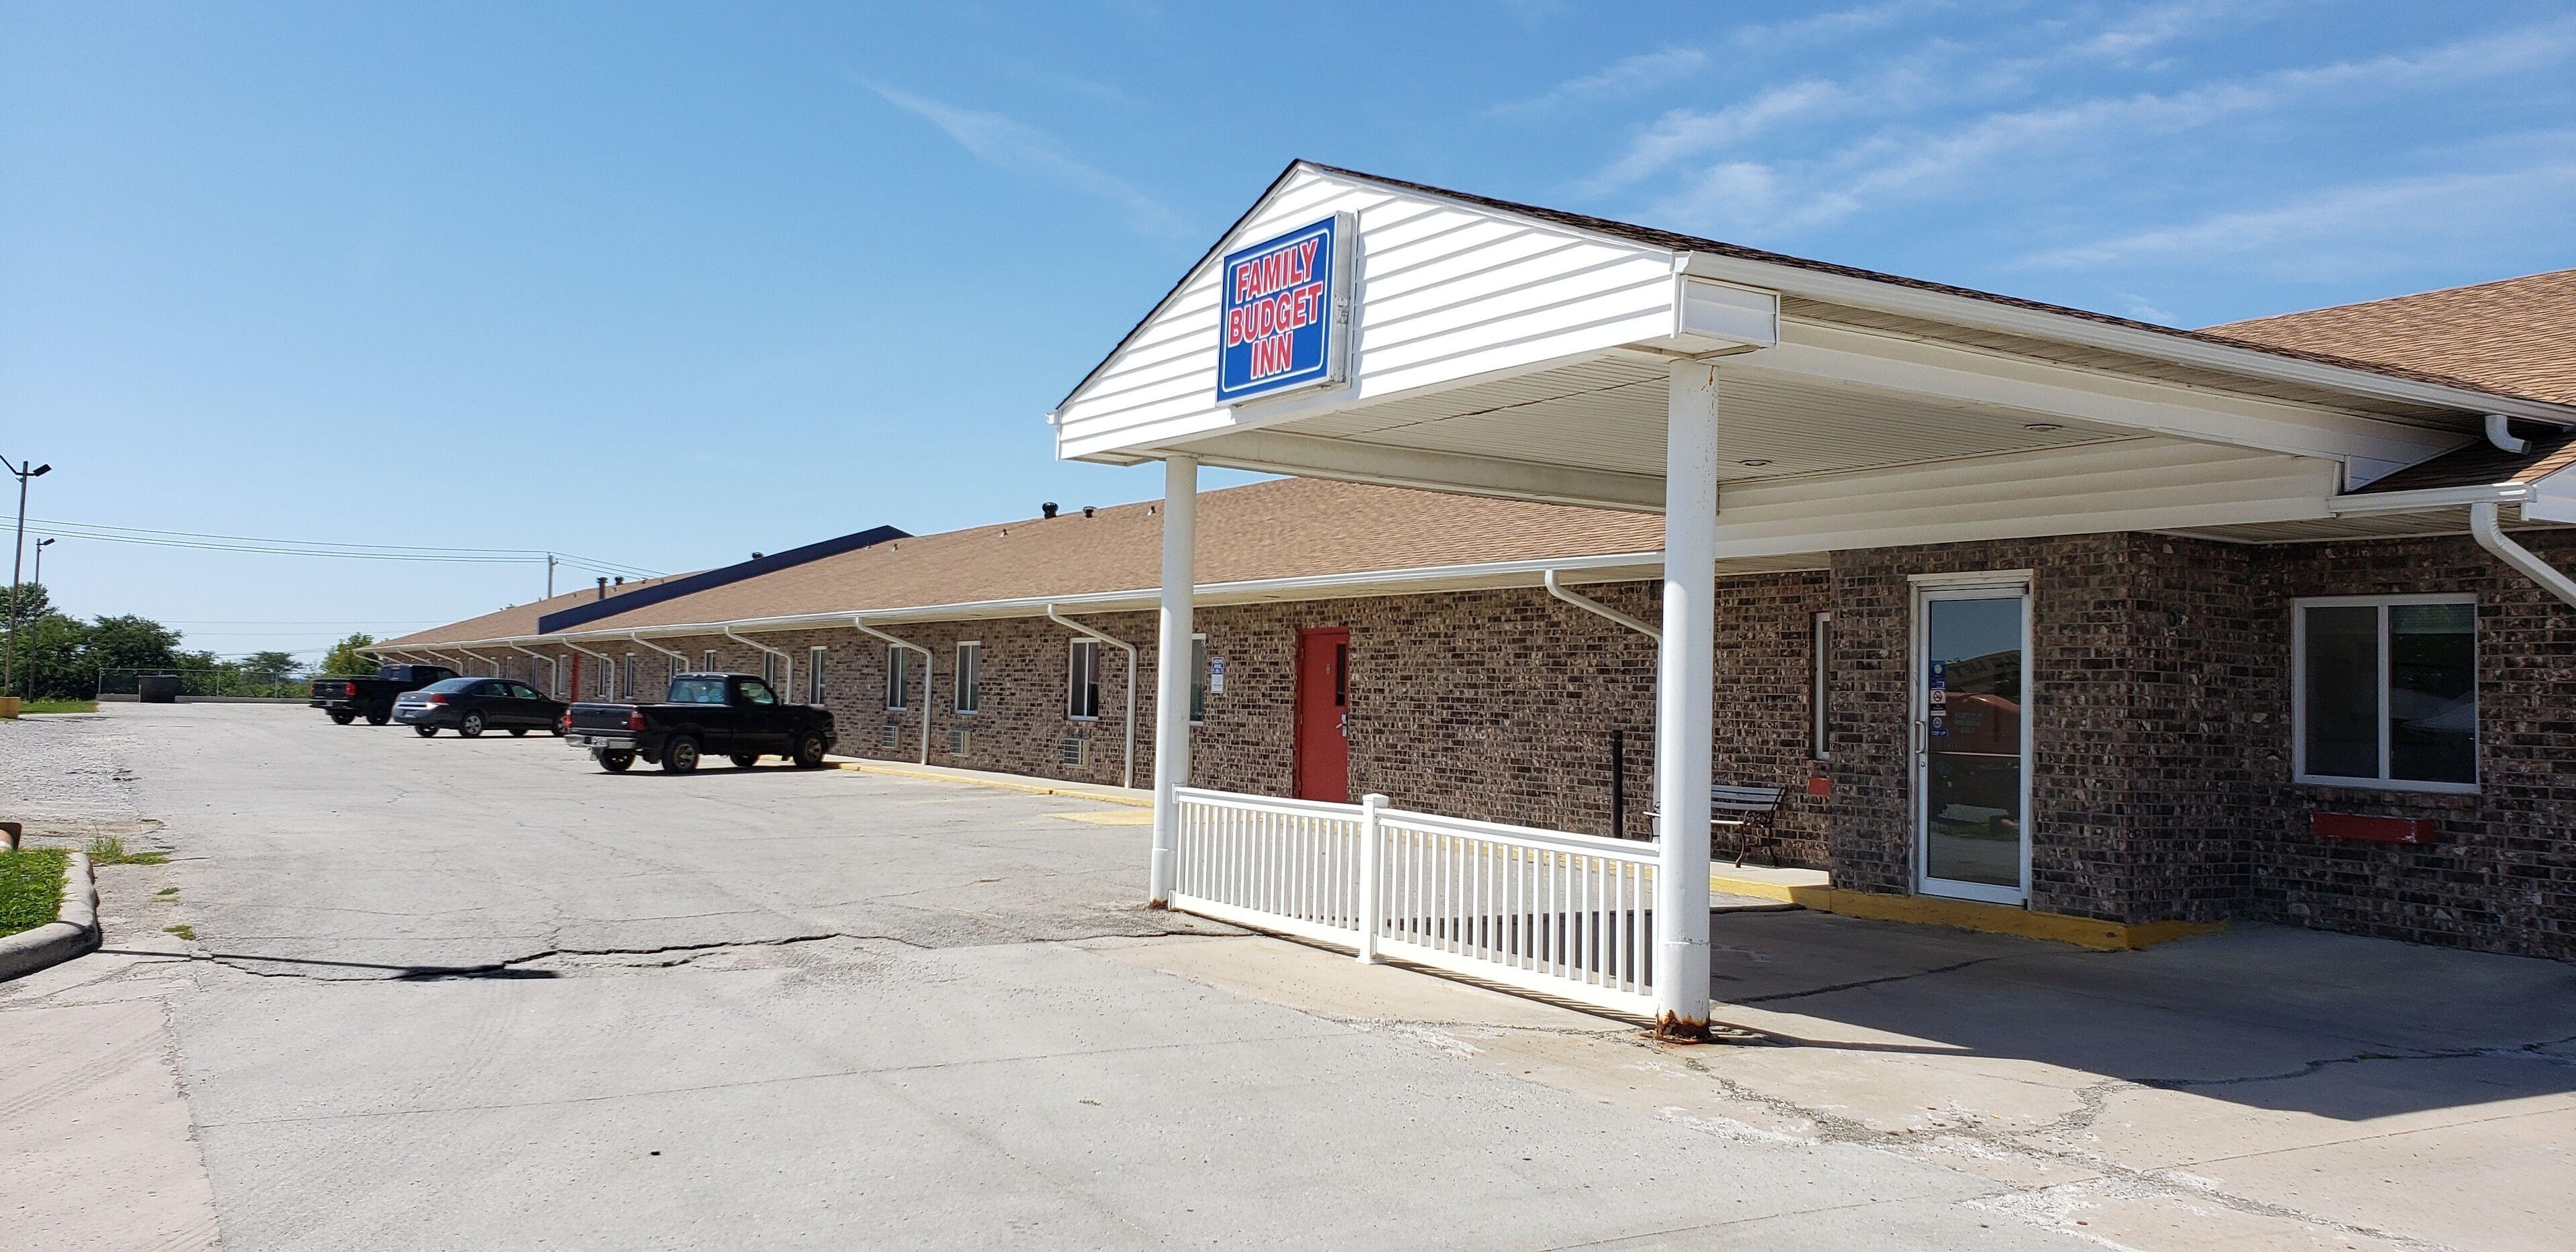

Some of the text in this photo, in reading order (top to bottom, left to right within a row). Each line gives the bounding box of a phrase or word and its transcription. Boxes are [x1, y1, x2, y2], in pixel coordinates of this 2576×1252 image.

[1236, 238, 1318, 304] FAMILY
[1228, 281, 1323, 348] BUDGET
[1250, 331, 1293, 380] INN
